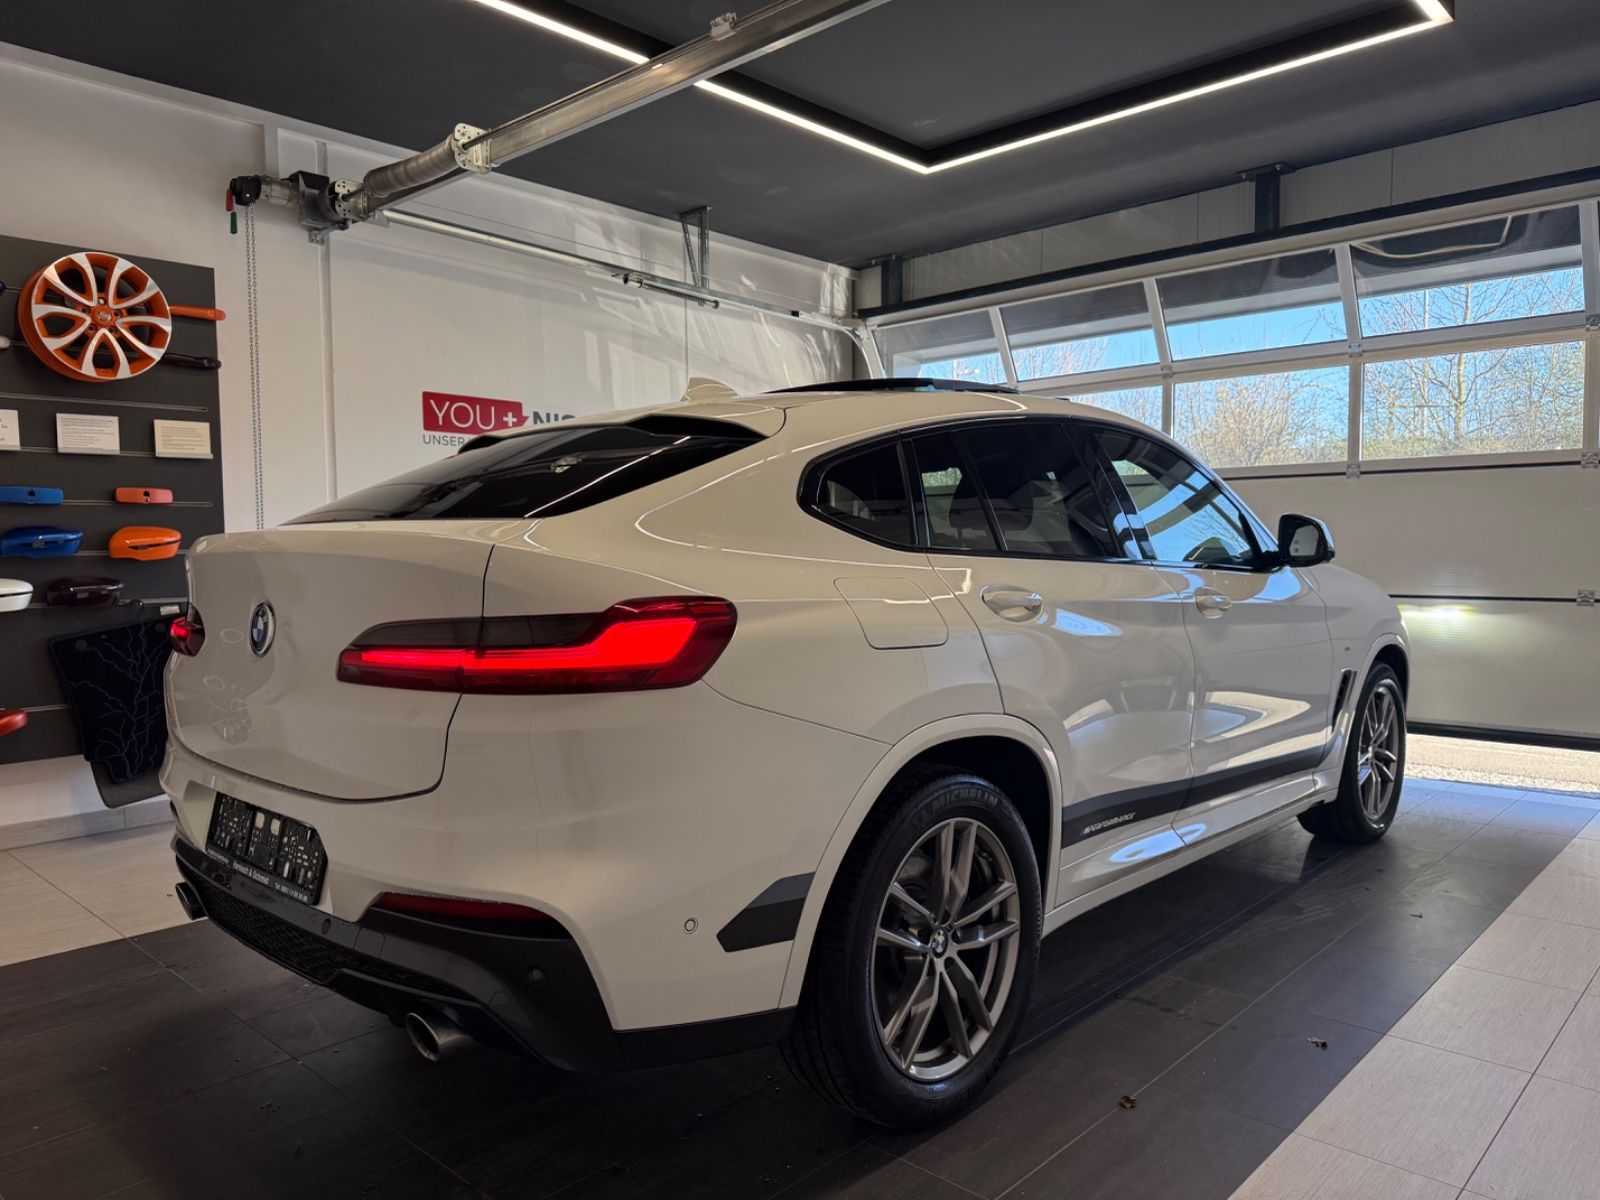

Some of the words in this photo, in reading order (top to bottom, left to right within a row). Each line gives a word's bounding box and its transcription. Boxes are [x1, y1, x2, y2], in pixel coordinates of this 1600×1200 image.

[430, 399, 495, 430] YOU
[423, 434, 466, 447] UNSER
[932, 788, 999, 812] MICHELIN
